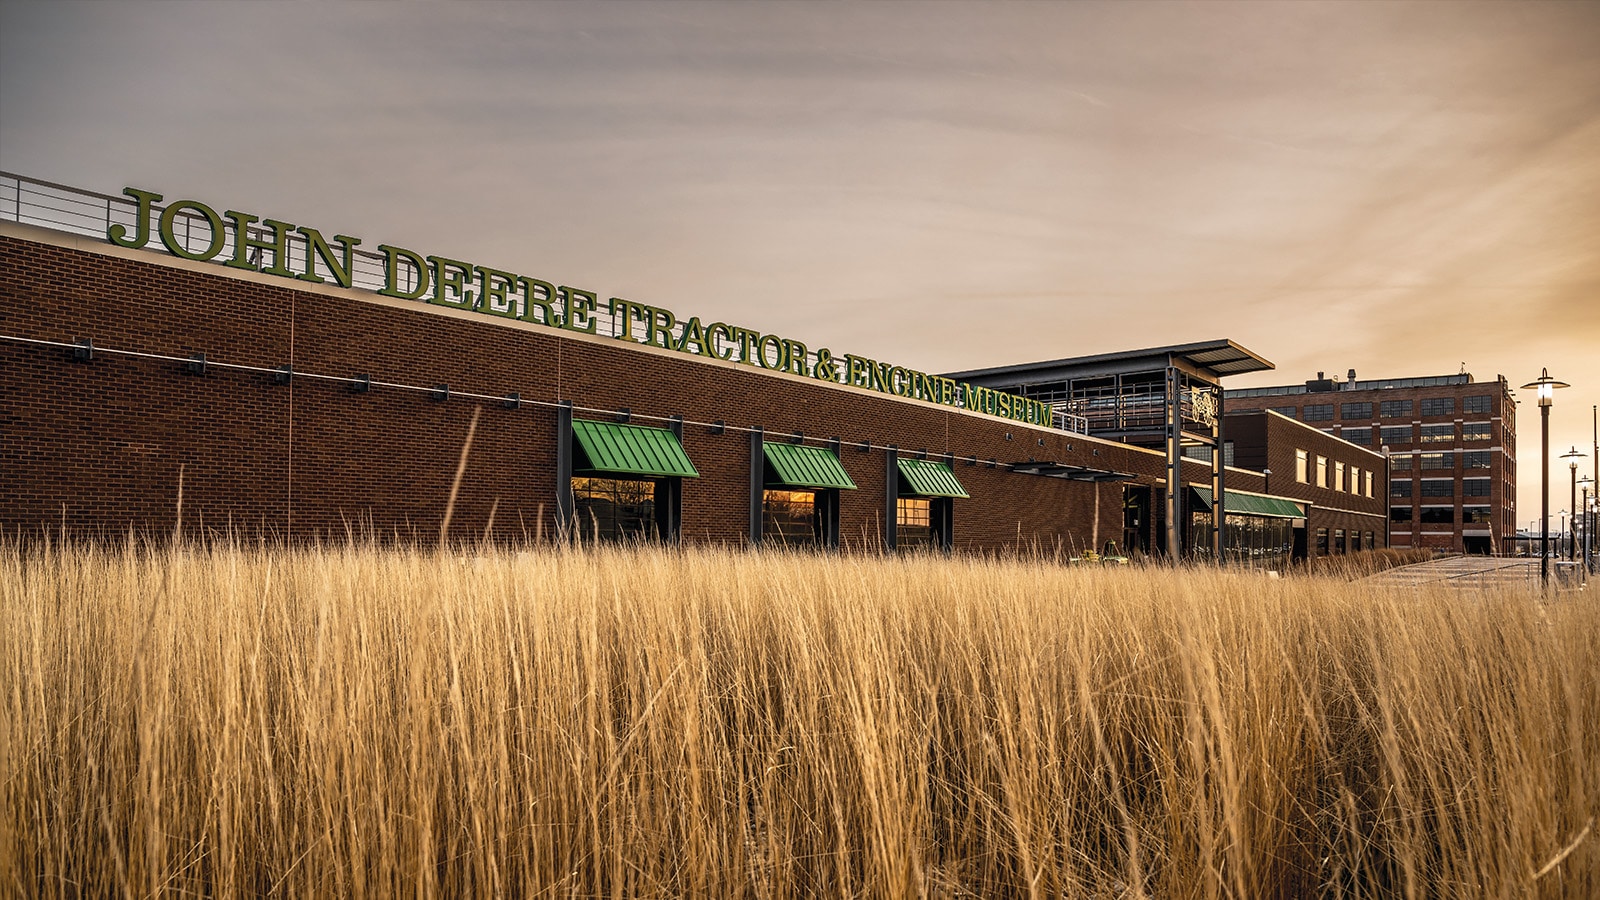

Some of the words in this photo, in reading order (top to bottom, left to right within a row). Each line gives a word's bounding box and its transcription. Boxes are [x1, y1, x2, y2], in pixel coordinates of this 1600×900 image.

[107, 187, 361, 288] JOHN
[377, 244, 597, 334] DEERE
[609, 297, 810, 377] TRACTOR
[814, 348, 840, 383] &
[844, 353, 956, 406] ENGINE
[960, 382, 1054, 428] MUSEUM
